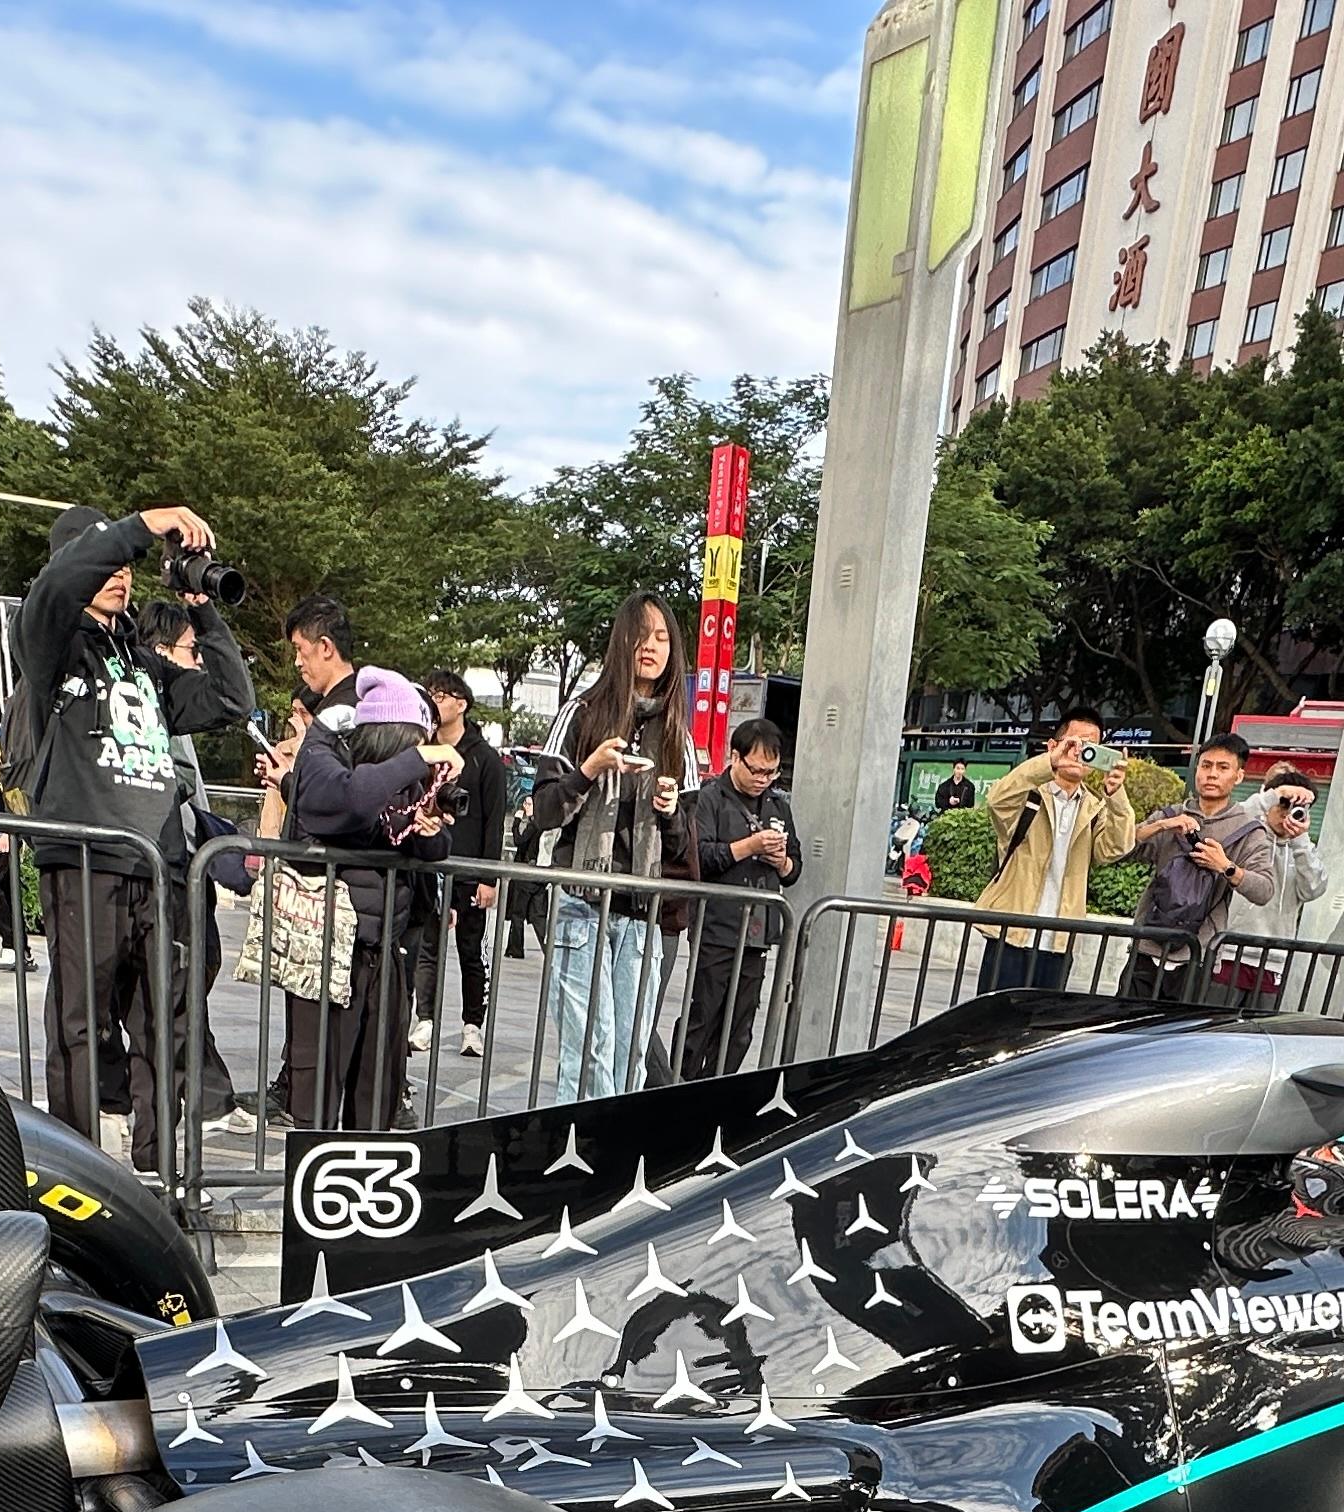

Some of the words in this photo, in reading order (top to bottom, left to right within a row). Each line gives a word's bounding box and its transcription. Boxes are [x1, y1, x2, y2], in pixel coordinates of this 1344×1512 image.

[1108, 0, 1186, 345] 國大酒
[703, 614, 716, 637] C
[723, 615, 733, 639] C
[97, 737, 176, 780] Aape
[293, 1141, 422, 1240] 63
[1023, 1178, 1199, 1220] SOLERA
